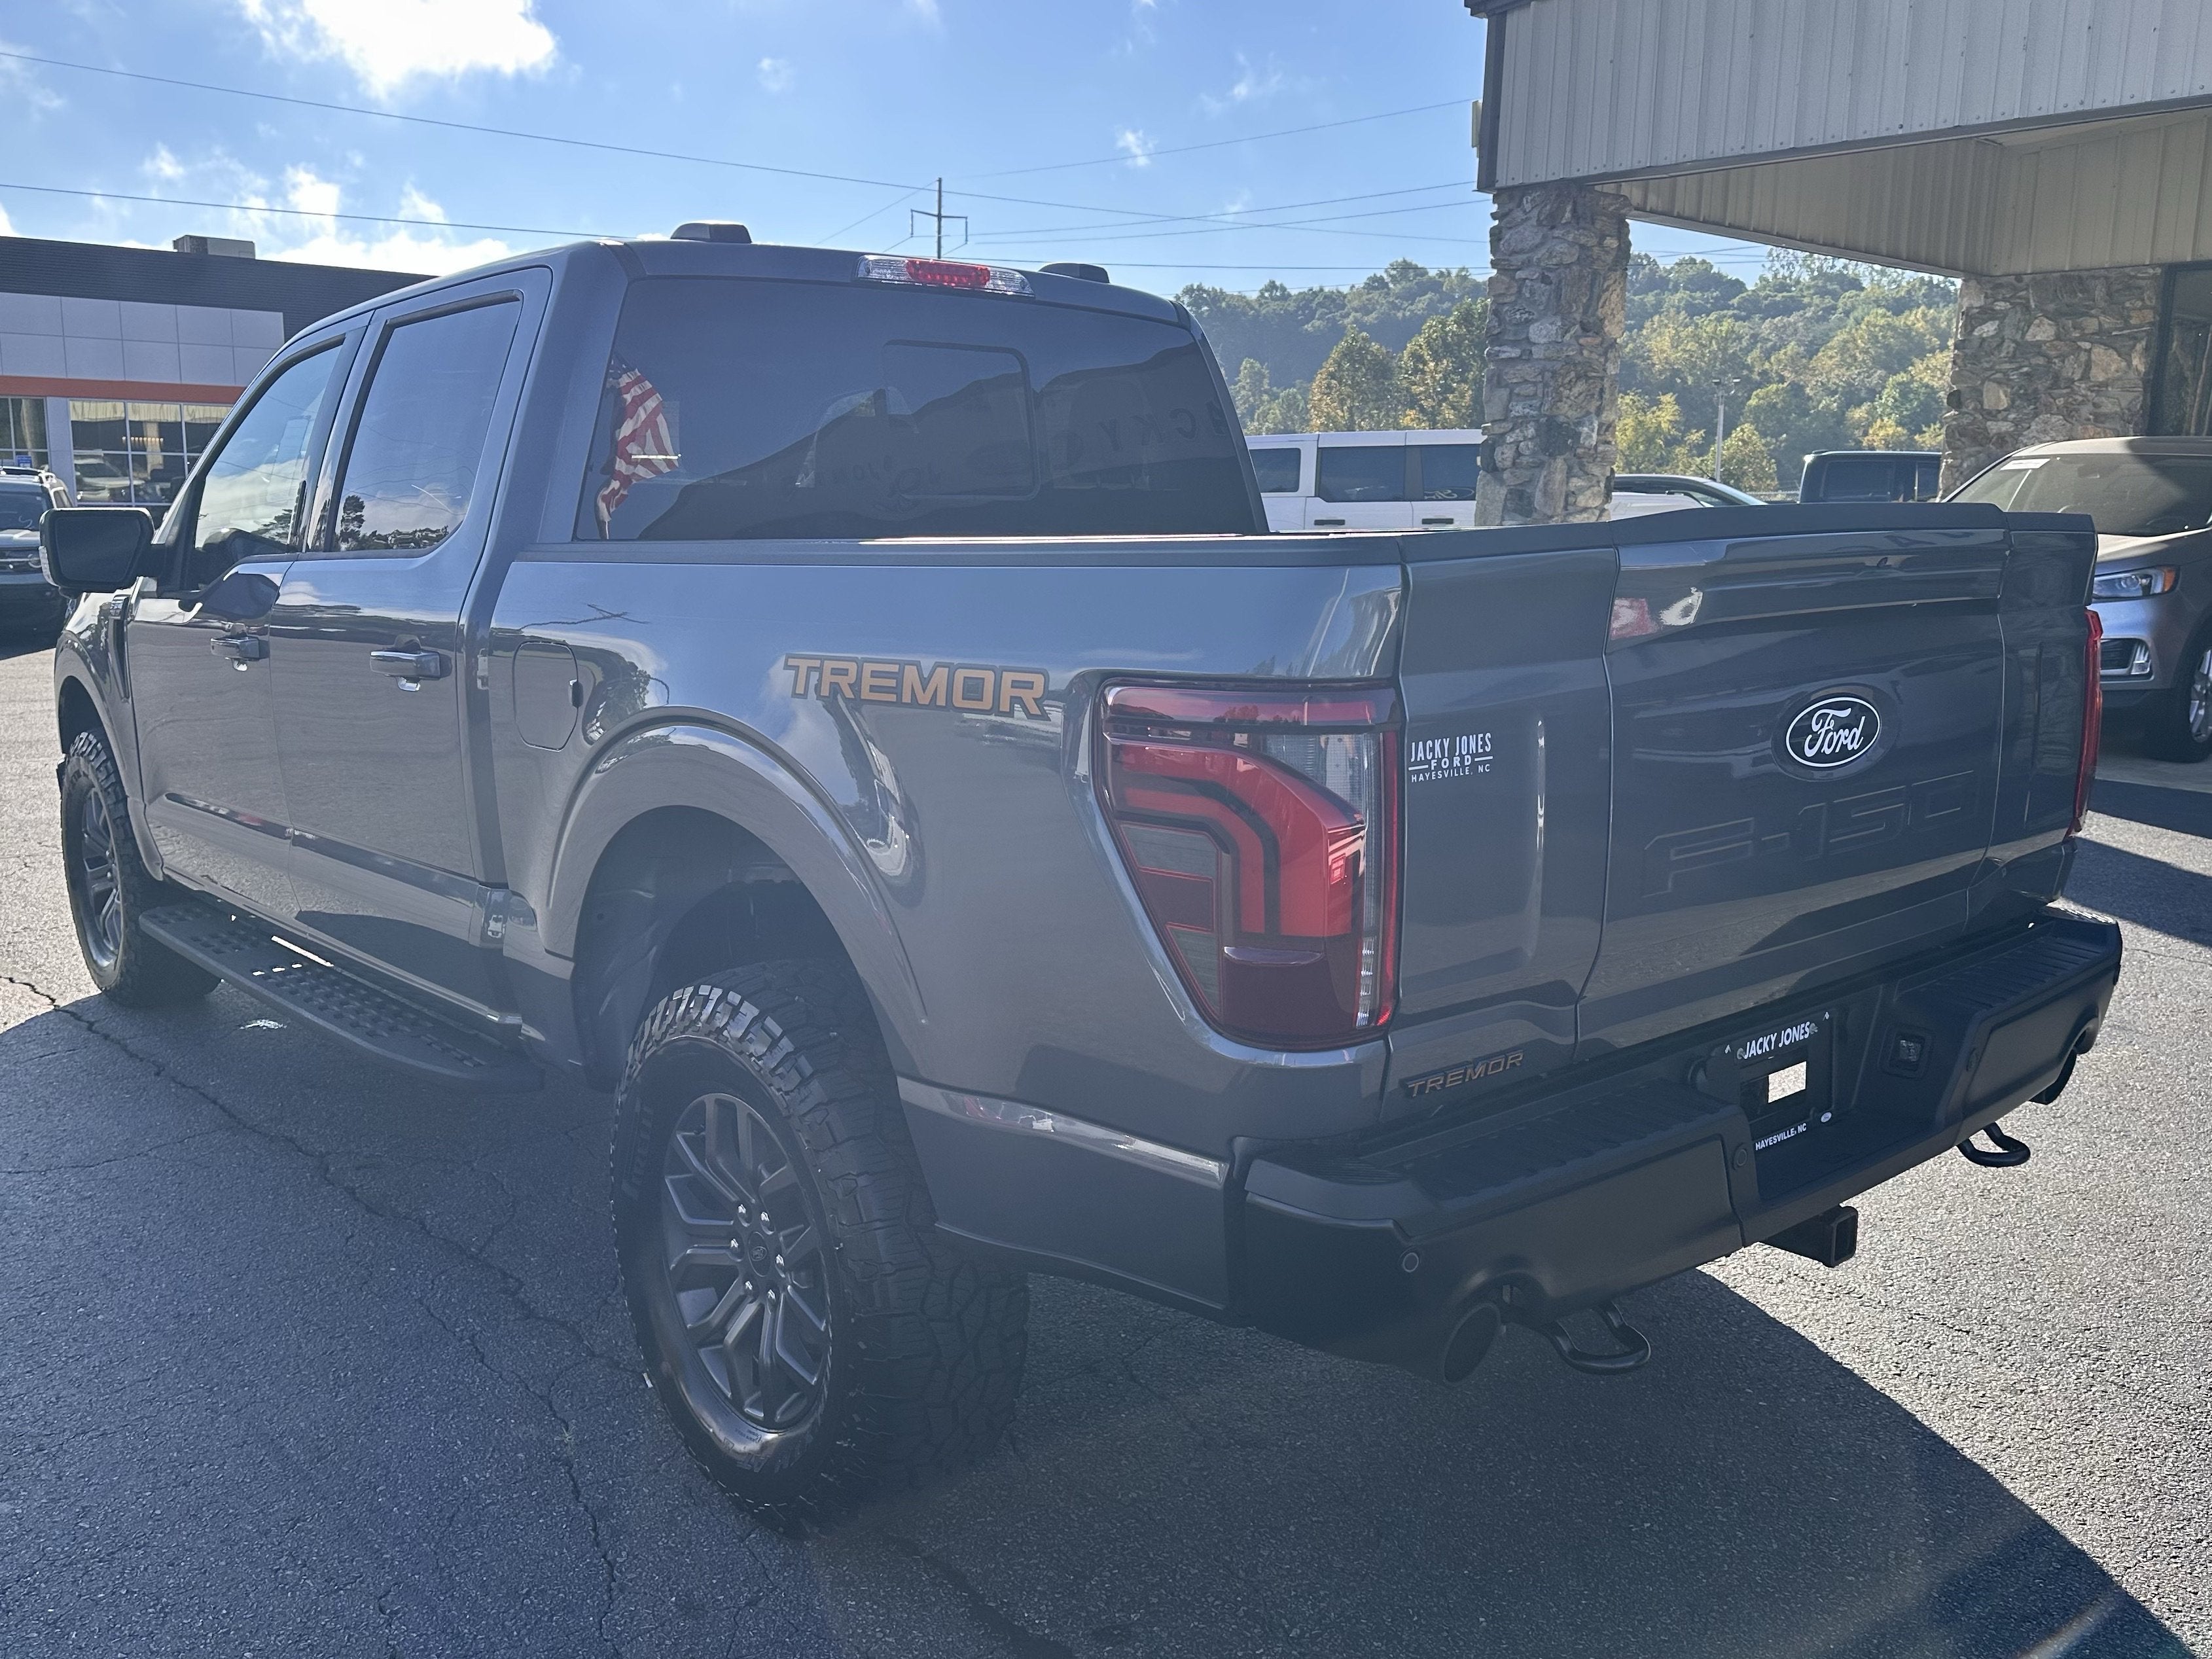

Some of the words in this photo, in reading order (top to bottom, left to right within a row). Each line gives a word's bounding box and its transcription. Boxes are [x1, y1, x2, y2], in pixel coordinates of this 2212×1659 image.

[785, 656, 1048, 719] TREMOR
[1411, 738, 1450, 762] JACKY
[1455, 732, 1491, 757] JONES
[1804, 707, 1866, 758] Ford
[1411, 767, 1473, 783] HAYESVILLE,
[1478, 764, 1490, 774] NC
[1431, 755, 1472, 770] FORD
[1643, 770, 1980, 899] F-150
[1743, 1032, 1777, 1060] JACKY
[1778, 1021, 1811, 1048] JONES
[1408, 1049, 1524, 1097] TREMOR
[1755, 1127, 1797, 1151] HAYESVILLE,
[1797, 1122, 1807, 1133] NC
